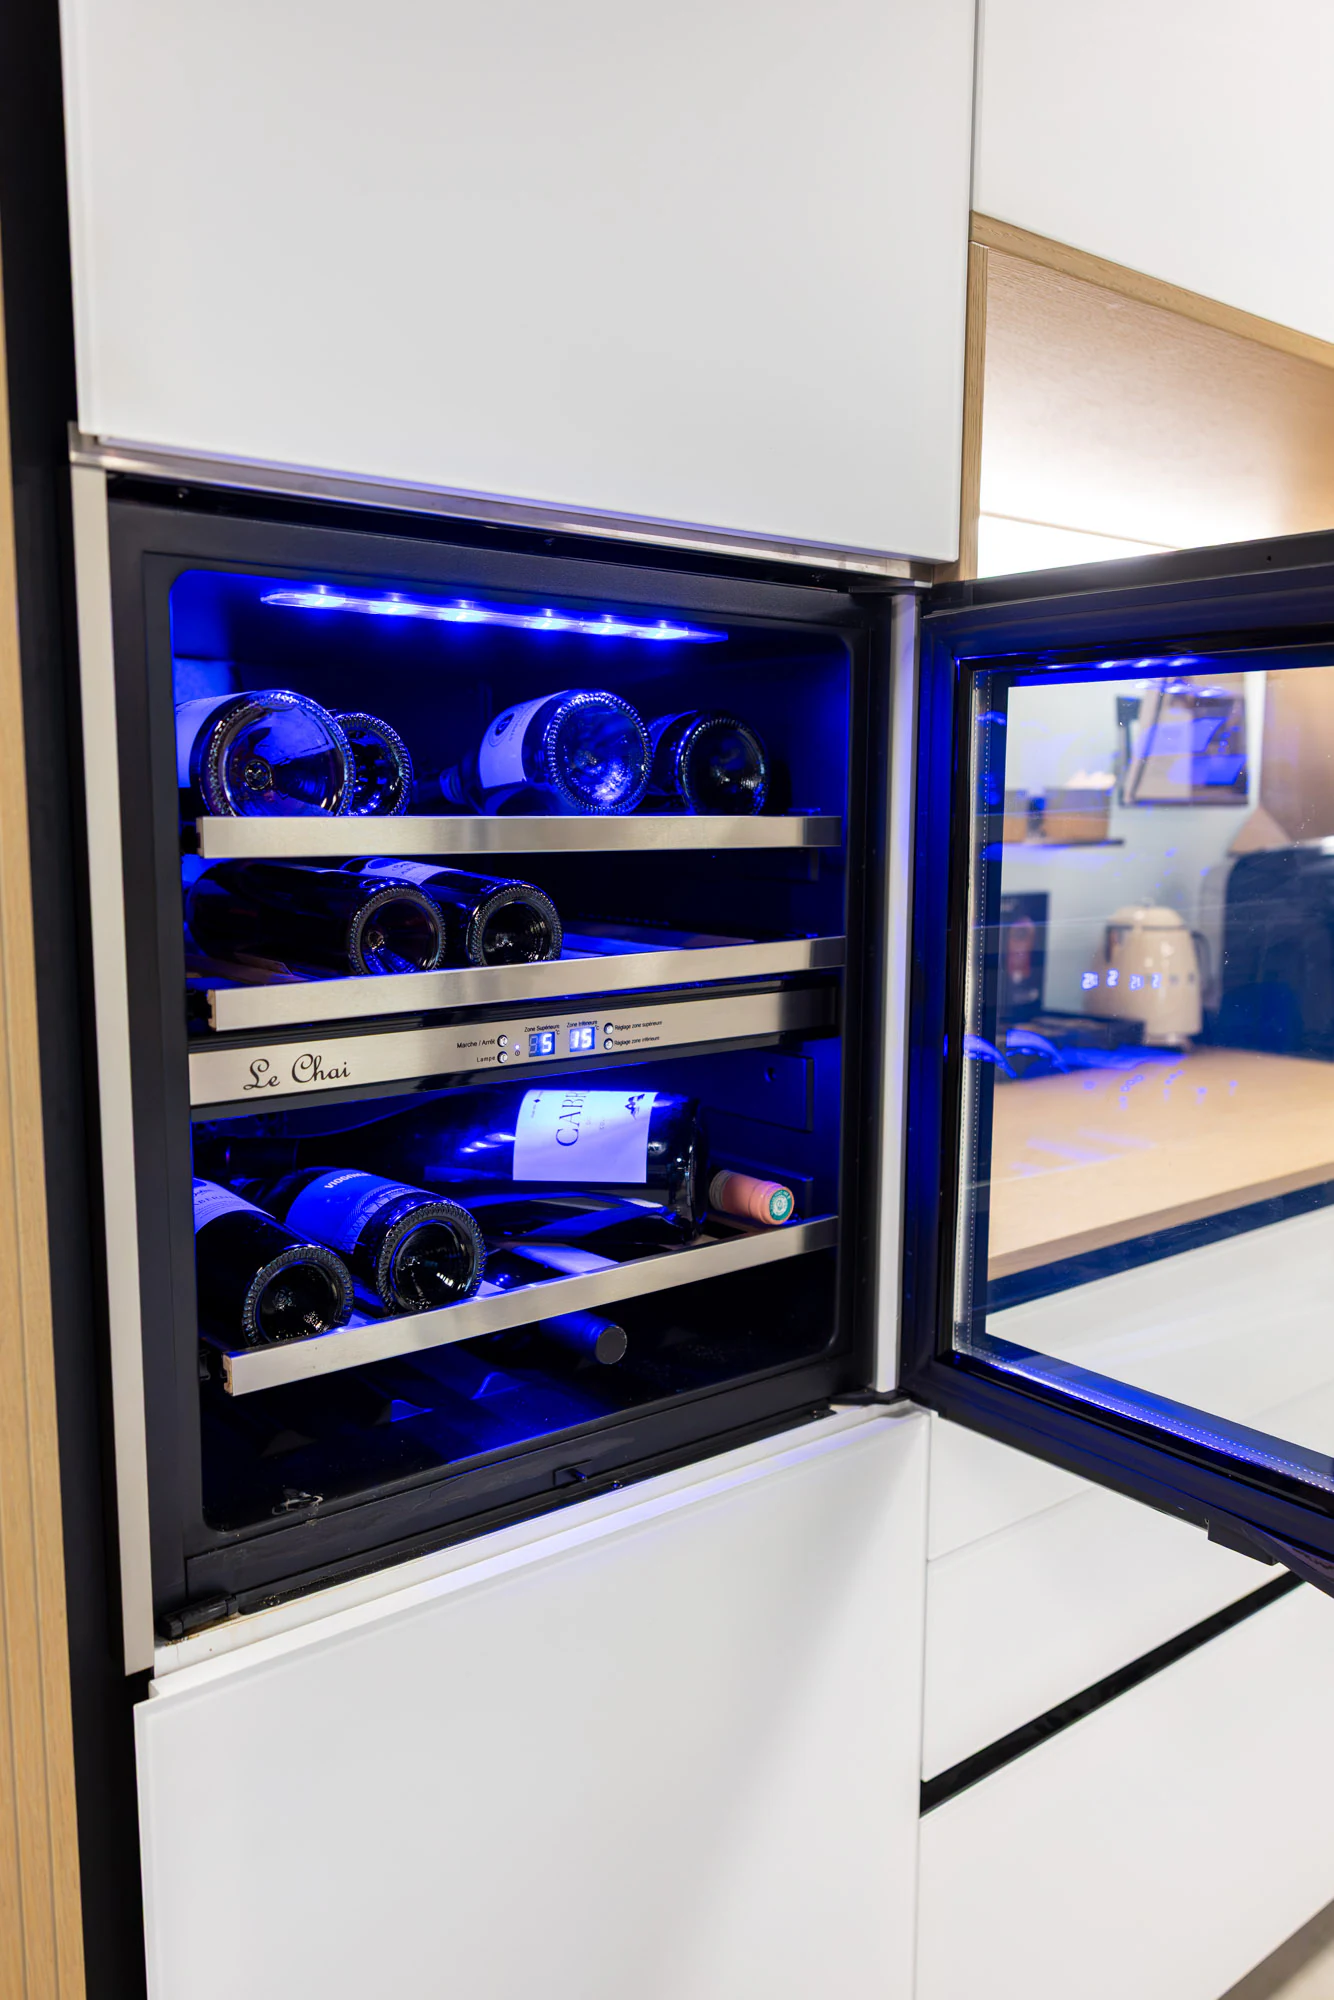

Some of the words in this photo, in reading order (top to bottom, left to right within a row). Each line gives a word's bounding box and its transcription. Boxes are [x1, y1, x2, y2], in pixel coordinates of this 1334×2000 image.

[541, 1033, 552, 1053] 5
[573, 1028, 592, 1049] 15
[243, 1058, 280, 1090] Le
[291, 1053, 351, 1083] Chai
